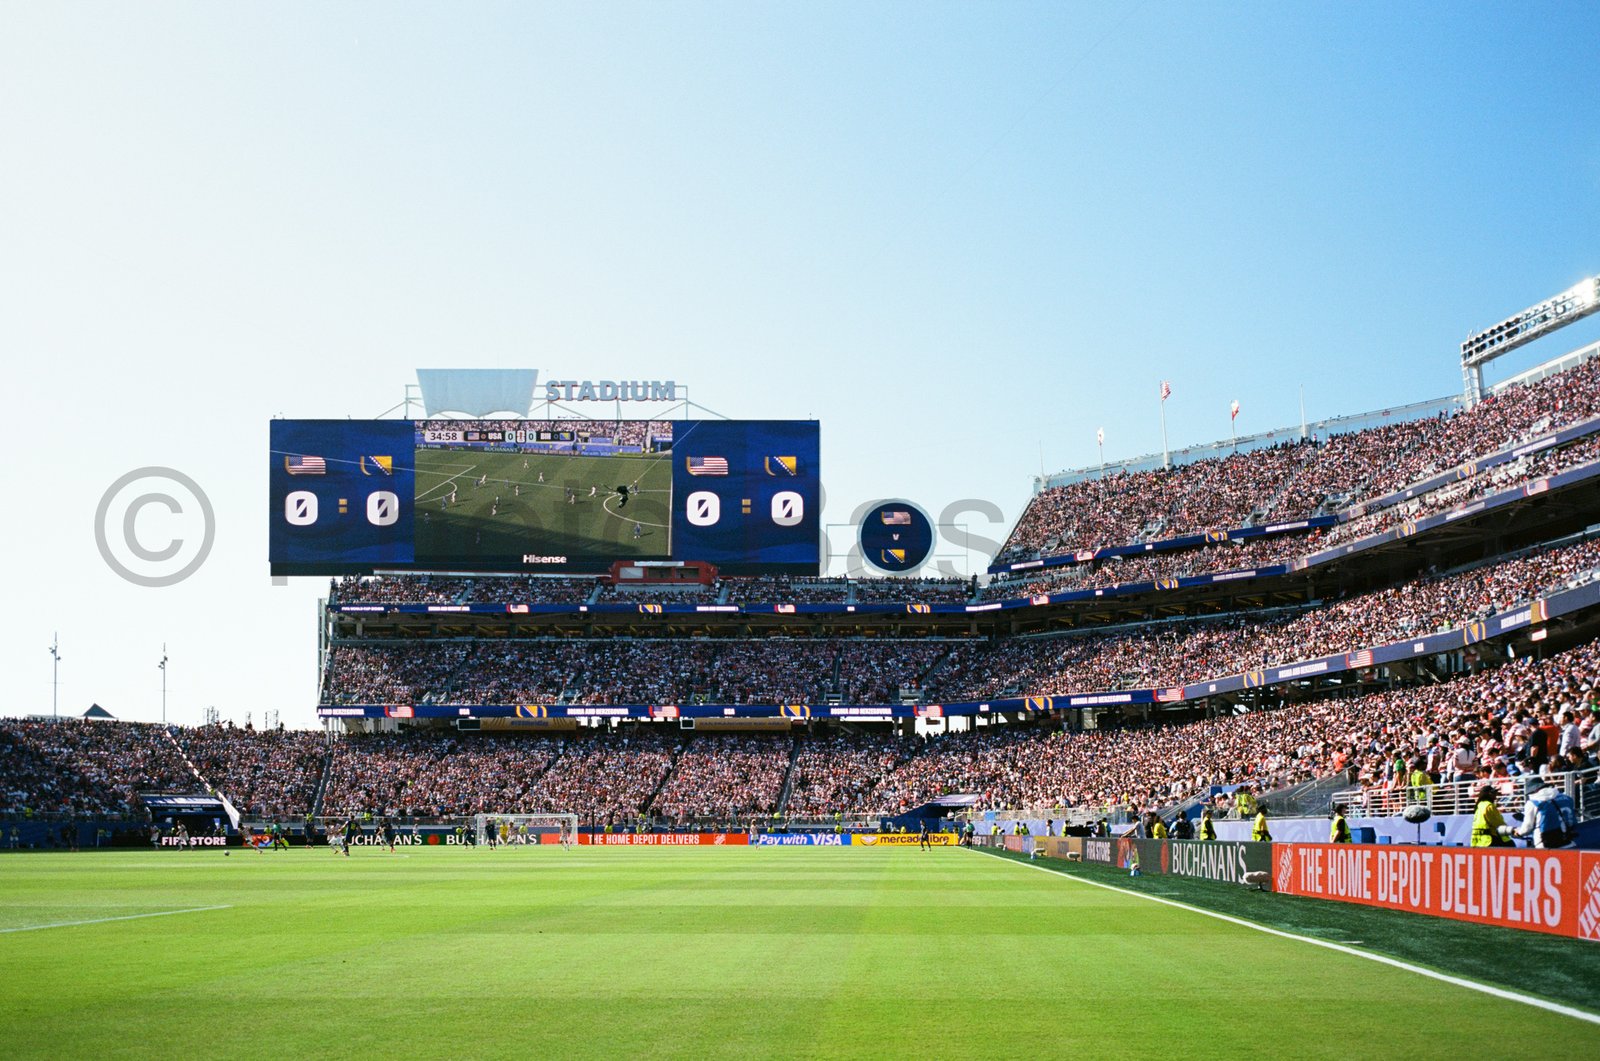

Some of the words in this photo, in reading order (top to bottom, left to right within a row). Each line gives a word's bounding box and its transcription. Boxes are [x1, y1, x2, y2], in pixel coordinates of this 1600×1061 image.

[545, 380, 675, 401] STADIUM
[430, 432, 457, 440] 34:58
[488, 432, 502, 440] USA
[285, 491, 319, 526] 0
[366, 491, 399, 526] 0
[686, 491, 720, 526] 0
[771, 491, 804, 526] 0
[523, 554, 567, 564] Hisense
[162, 837, 187, 846] FIFA
[190, 836, 226, 846] STORE
[346, 834, 422, 846] UCHAAN'S
[446, 834, 537, 845] BUHANAN'S
[588, 834, 604, 844] THE
[606, 834, 627, 844] HOME
[633, 834, 659, 844] DEPOT
[661, 834, 699, 844] DELIVERS
[759, 834, 781, 845] Pay
[782, 834, 808, 845] with
[810, 834, 842, 845] VISA
[880, 834, 922, 844] mercad
[1172, 842, 1247, 884] BUCHANAN'S
[1299, 848, 1323, 893] THE
[1328, 849, 1372, 900] HOME
[1378, 850, 1434, 909] DEPOT
[1441, 853, 1562, 927] DELIVERS
